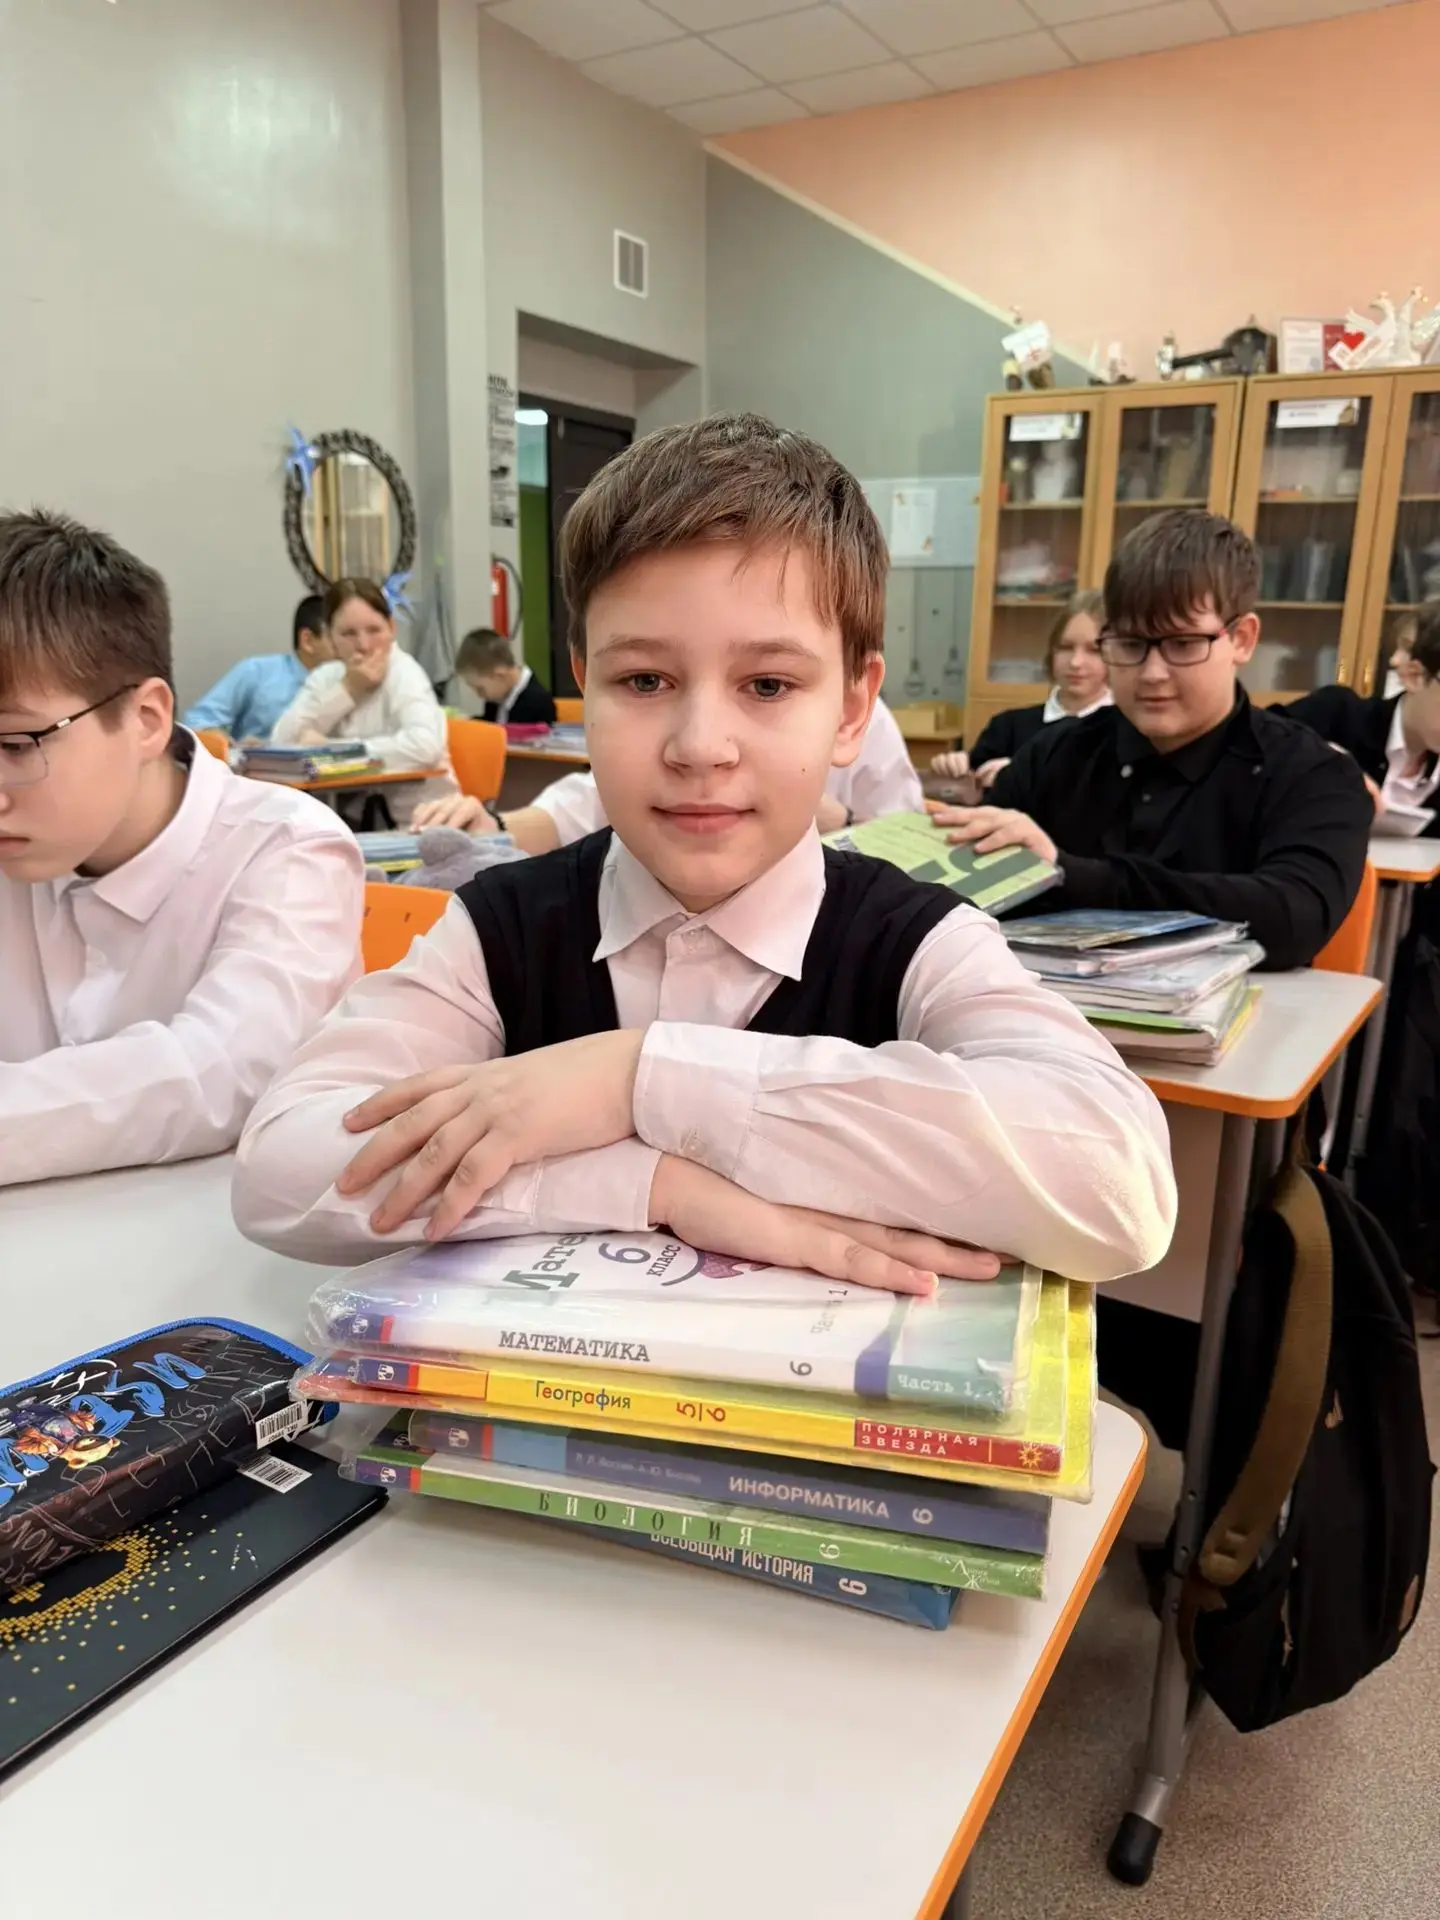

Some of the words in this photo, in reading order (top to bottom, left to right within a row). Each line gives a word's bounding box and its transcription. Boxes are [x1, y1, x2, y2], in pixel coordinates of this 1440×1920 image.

[498, 1330, 650, 1362] МАТЕМАТИКА
[789, 1360, 813, 1376] 6
[897, 1374, 954, 1393] Часть
[535, 1380, 631, 1411] География
[861, 1422, 978, 1447] ПОЛЯРНАЯ
[861, 1435, 946, 1455] ЗВЕЗДА
[728, 1476, 889, 1519] ИНФОРМАТИКА
[912, 1507, 934, 1525] 6
[538, 1490, 753, 1547] БИОЛОГИЯ
[818, 1543, 841, 1559] 6
[742, 1548, 814, 1585] ИСТОРИЯ
[838, 1577, 868, 1595] 6
